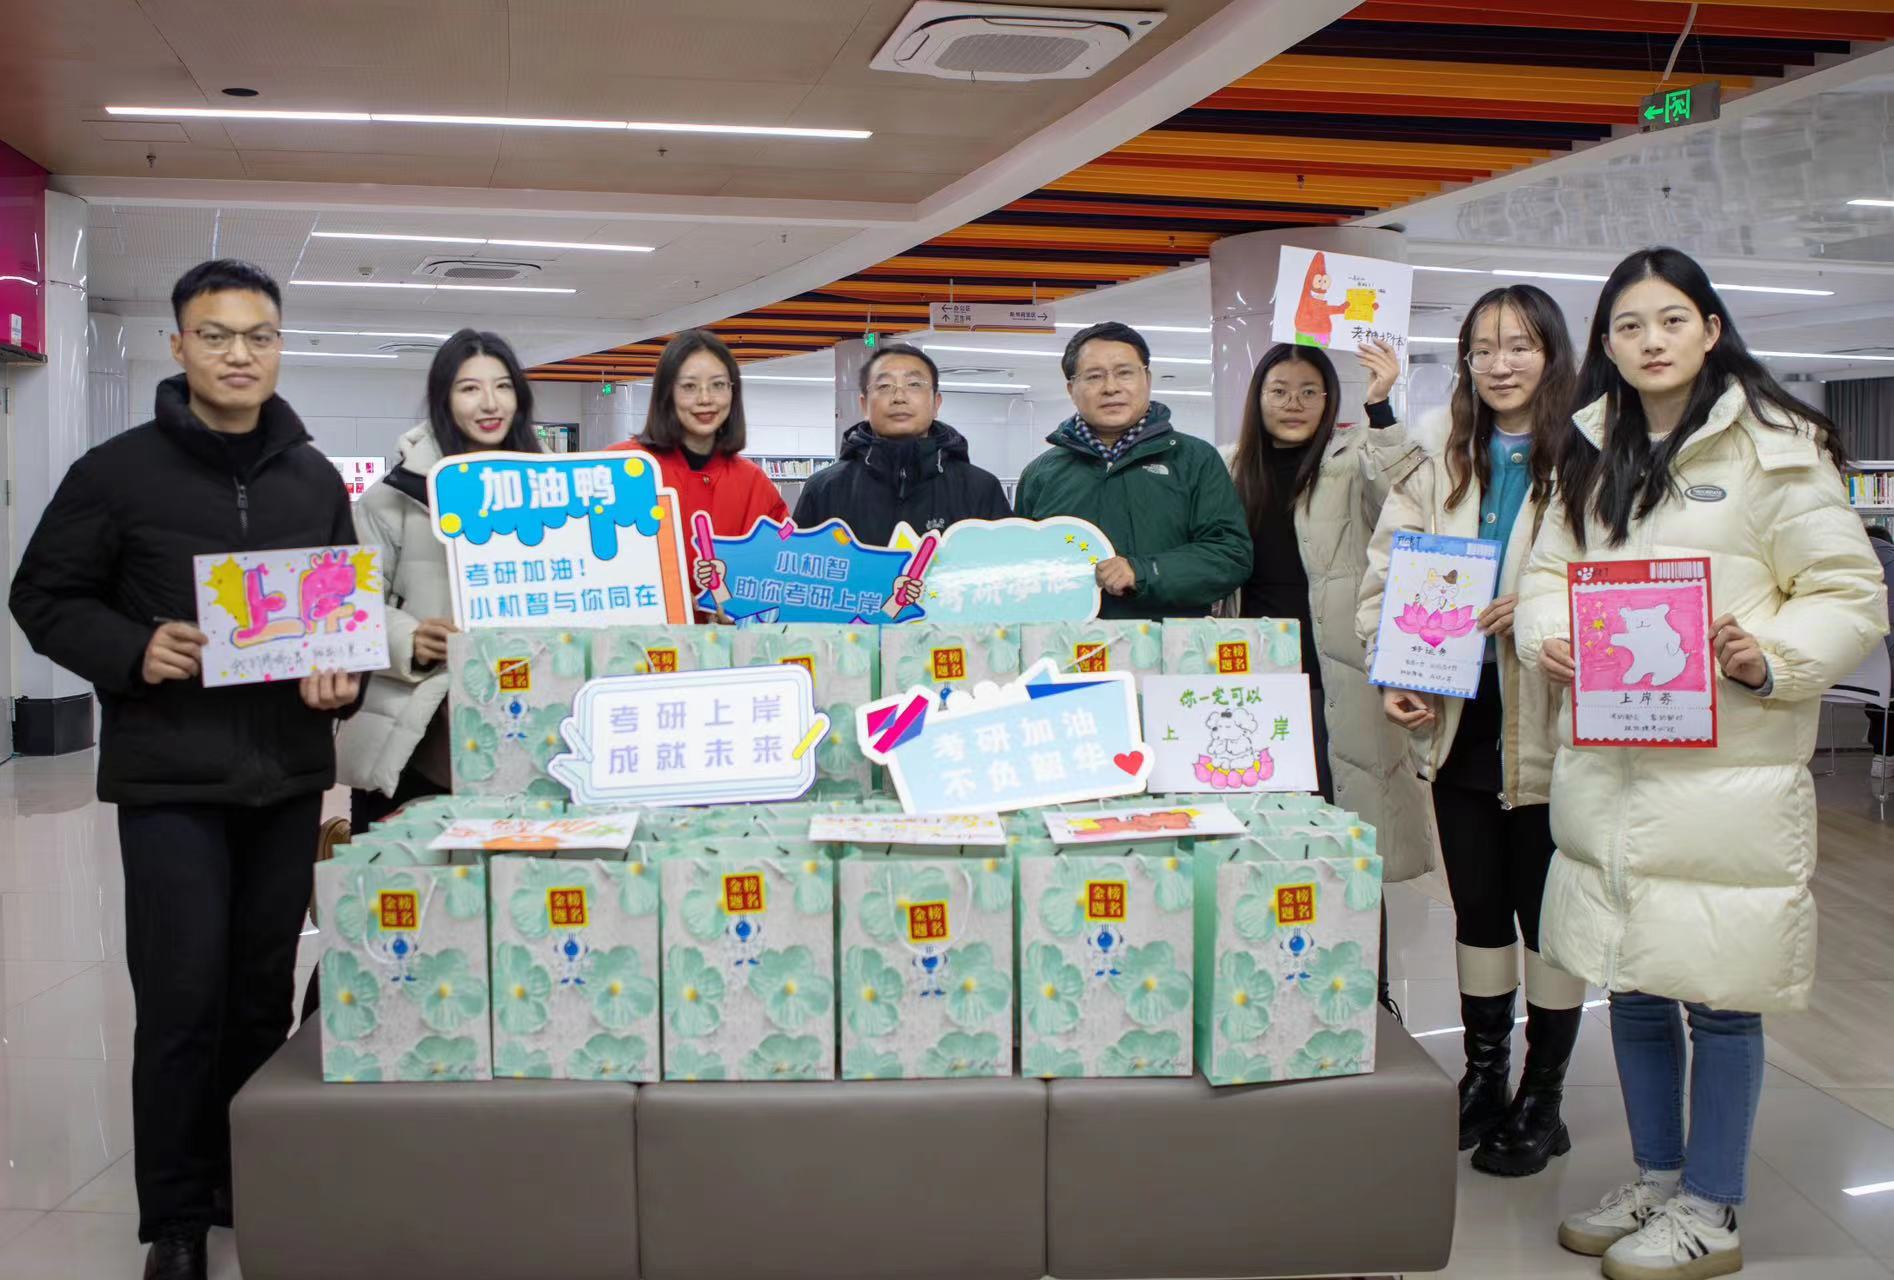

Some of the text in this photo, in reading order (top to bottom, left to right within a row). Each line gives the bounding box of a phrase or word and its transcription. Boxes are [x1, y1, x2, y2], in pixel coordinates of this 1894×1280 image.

[479, 464, 616, 511] 加油鸭
[464, 558, 586, 588] 考研加油！
[776, 550, 850, 581] 小机智
[469, 584, 659, 621] 小机智与你同在
[735, 577, 882, 614] 助你考研上岸
[610, 695, 782, 734] 考研上岸
[1180, 685, 1263, 709] 你一定可以
[1620, 692, 1673, 706] 上岸券
[932, 707, 1099, 761] 考研加油
[1162, 715, 1290, 741] 上 岸
[609, 735, 783, 775] 成就未来
